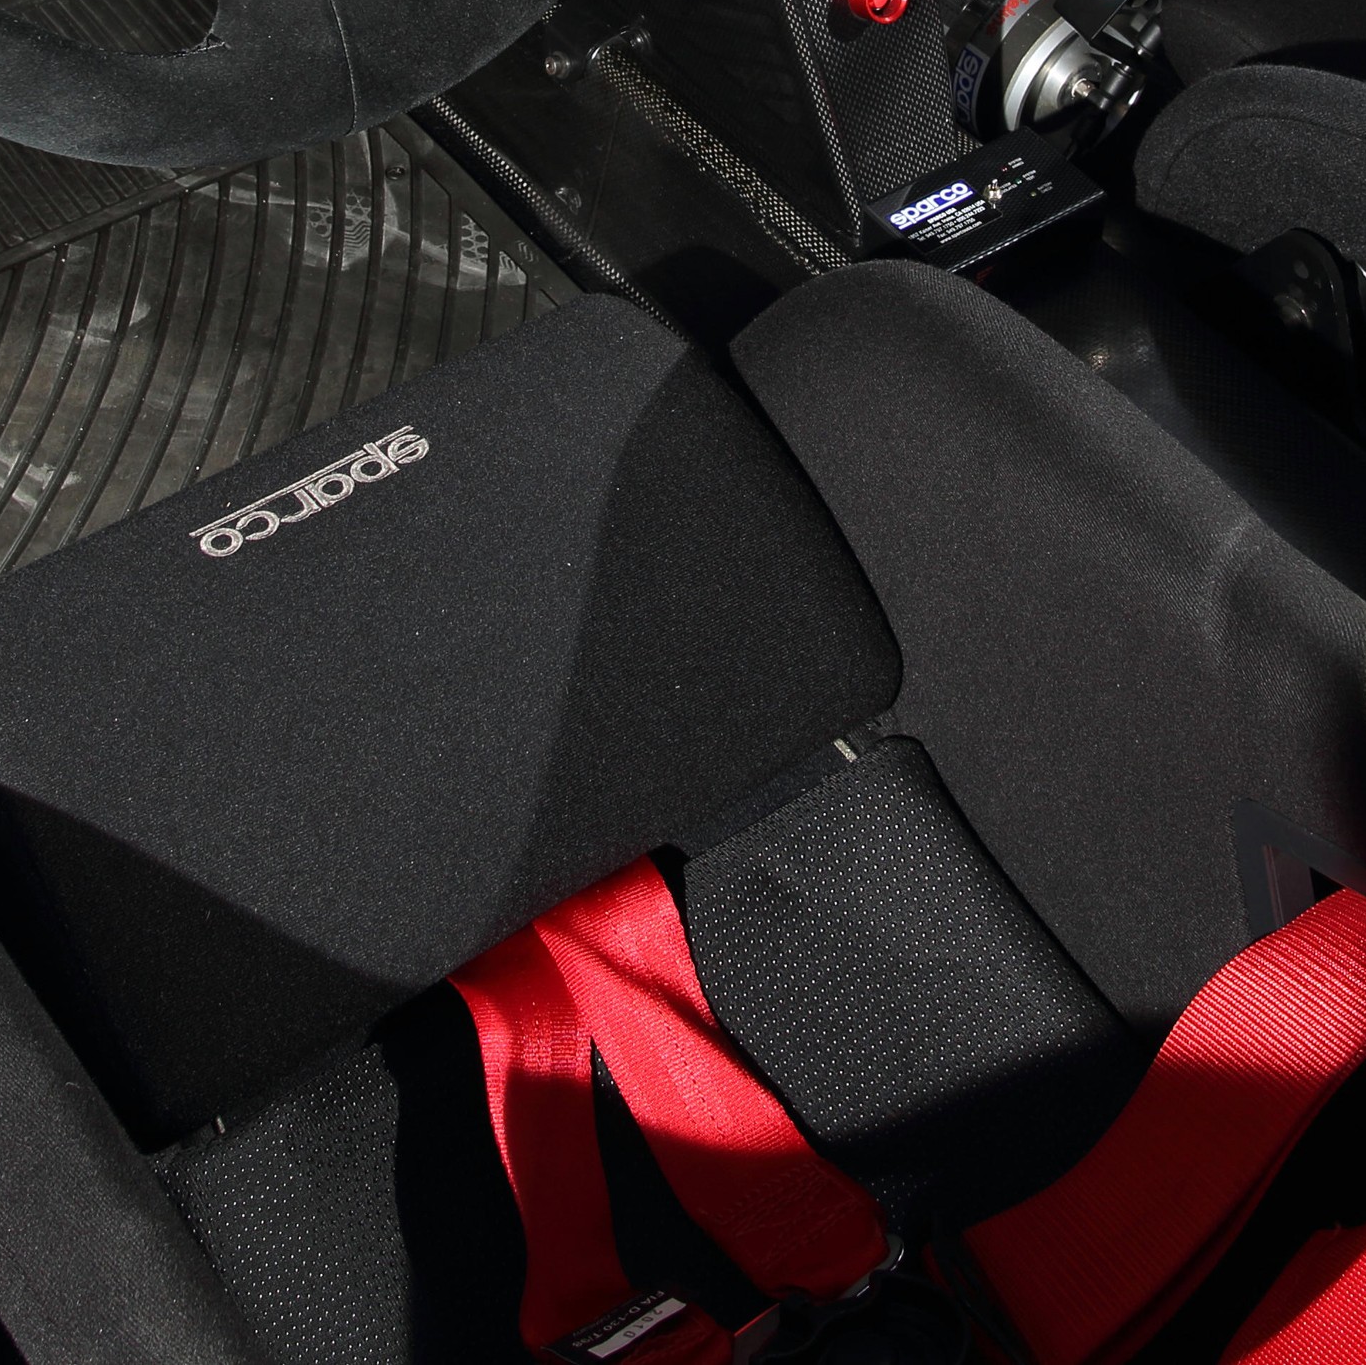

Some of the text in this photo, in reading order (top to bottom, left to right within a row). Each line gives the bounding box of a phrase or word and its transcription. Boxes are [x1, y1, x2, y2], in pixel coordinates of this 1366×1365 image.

[954, 49, 980, 124] spar
[890, 183, 972, 229] sparco
[195, 427, 430, 557] sparco
